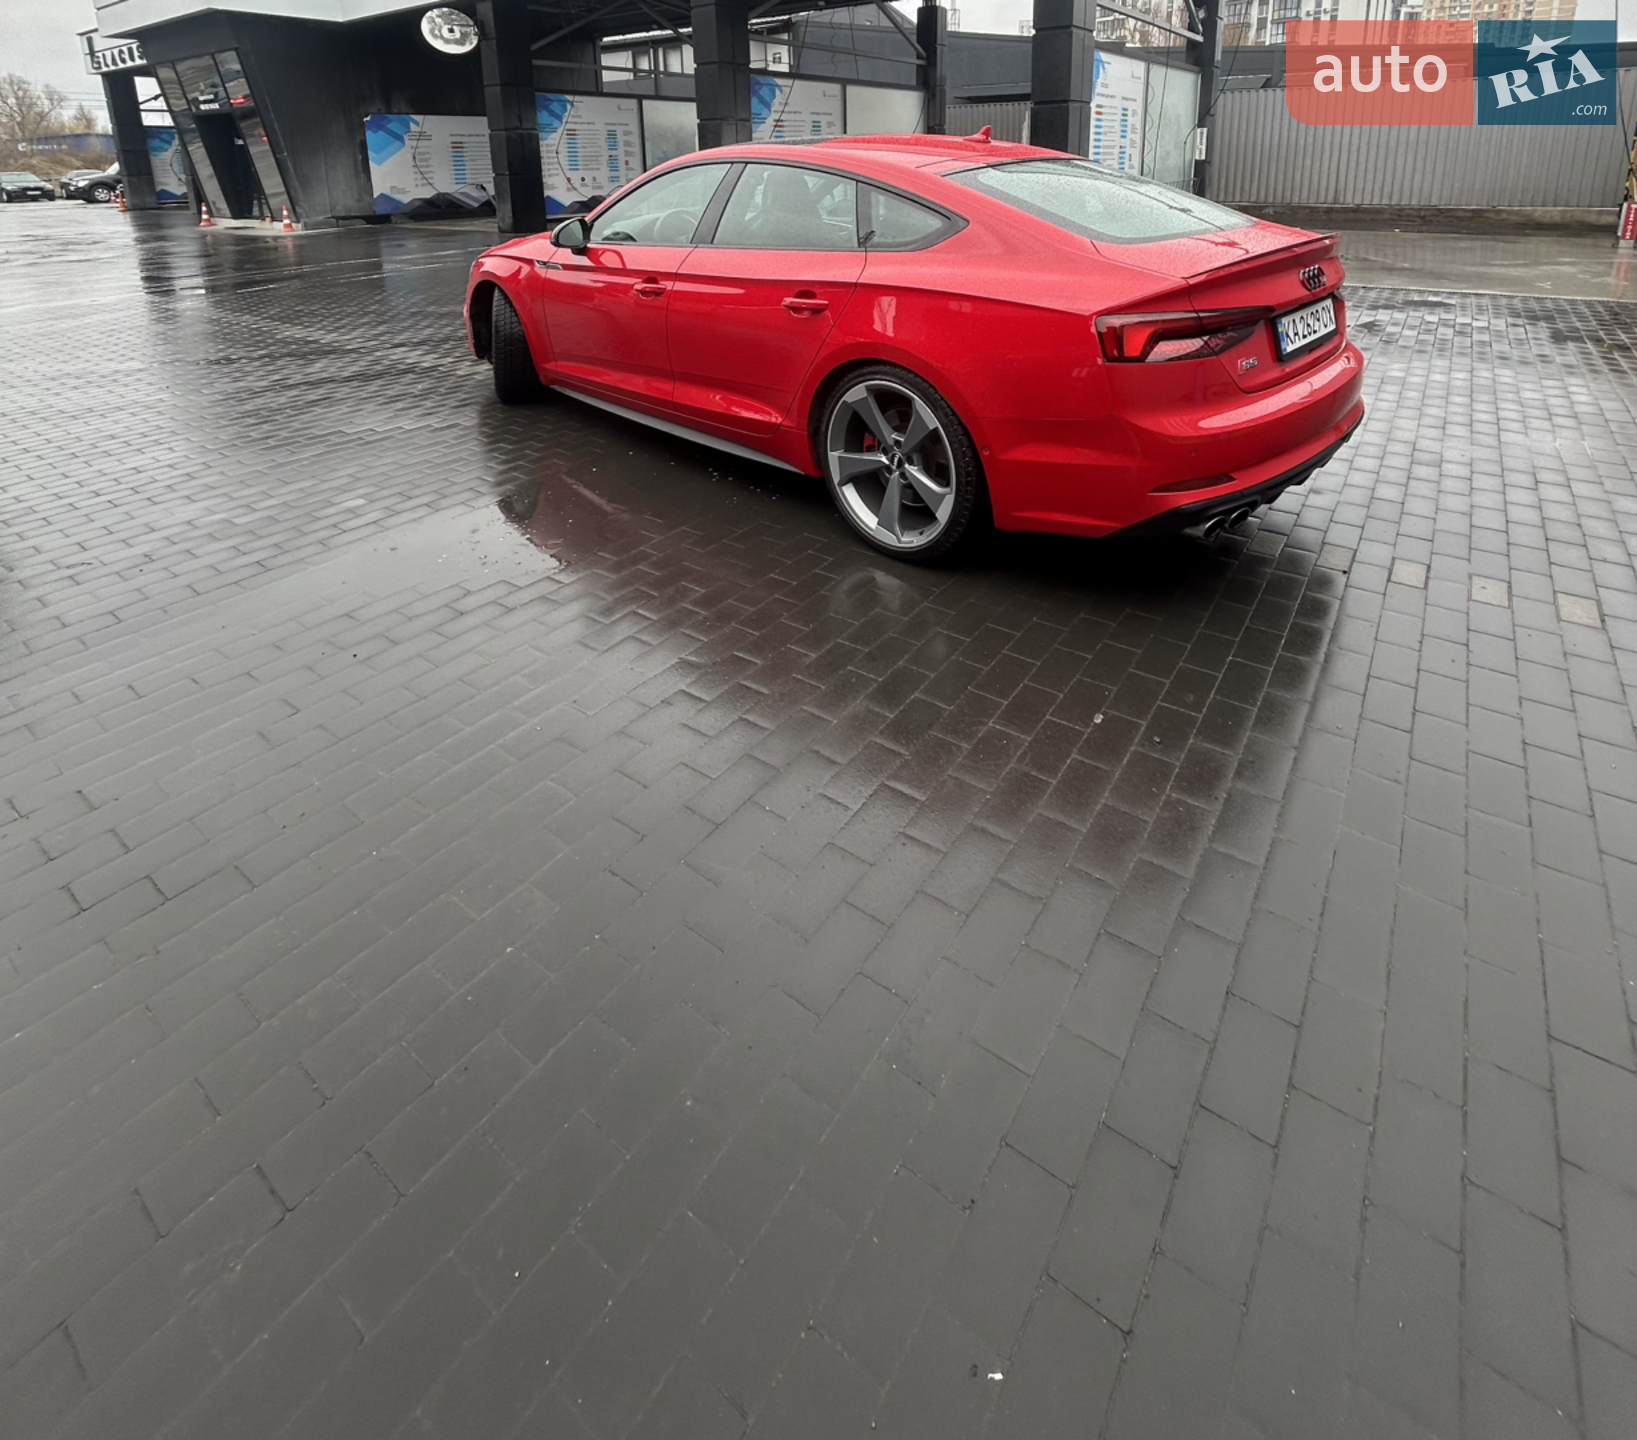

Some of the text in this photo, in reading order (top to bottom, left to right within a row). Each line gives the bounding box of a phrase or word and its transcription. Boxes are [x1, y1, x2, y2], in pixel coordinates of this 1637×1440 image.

[1283, 303, 1334, 346] KA 2629 OX
